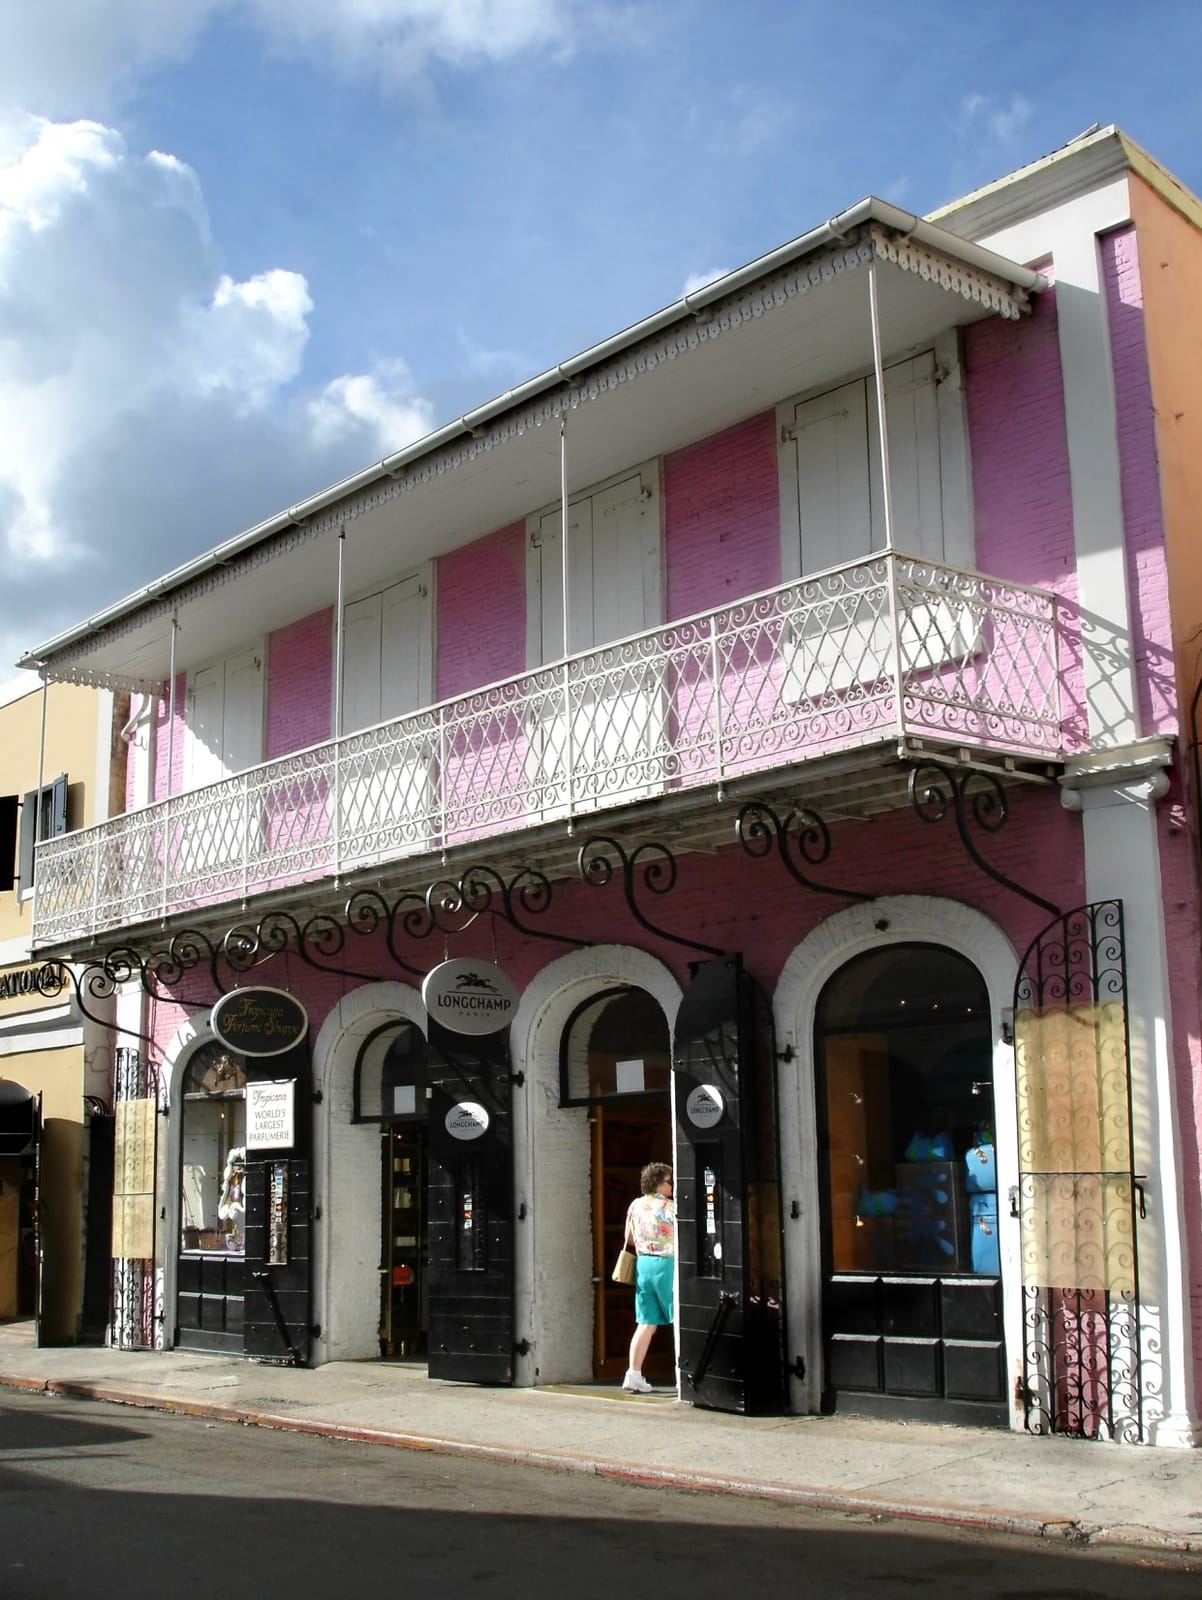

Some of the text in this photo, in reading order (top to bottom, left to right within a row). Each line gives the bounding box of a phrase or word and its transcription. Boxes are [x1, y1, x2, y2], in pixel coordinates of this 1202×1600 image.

[0, 964, 67, 997] ATIONAL
[438, 994, 511, 1011] LONGCHAMP
[252, 1089, 287, 1107] Tropicana
[254, 1108, 286, 1120] WORLD'S
[255, 1119, 284, 1130] LARGEST
[249, 1130, 289, 1142] PARFUMERIE
